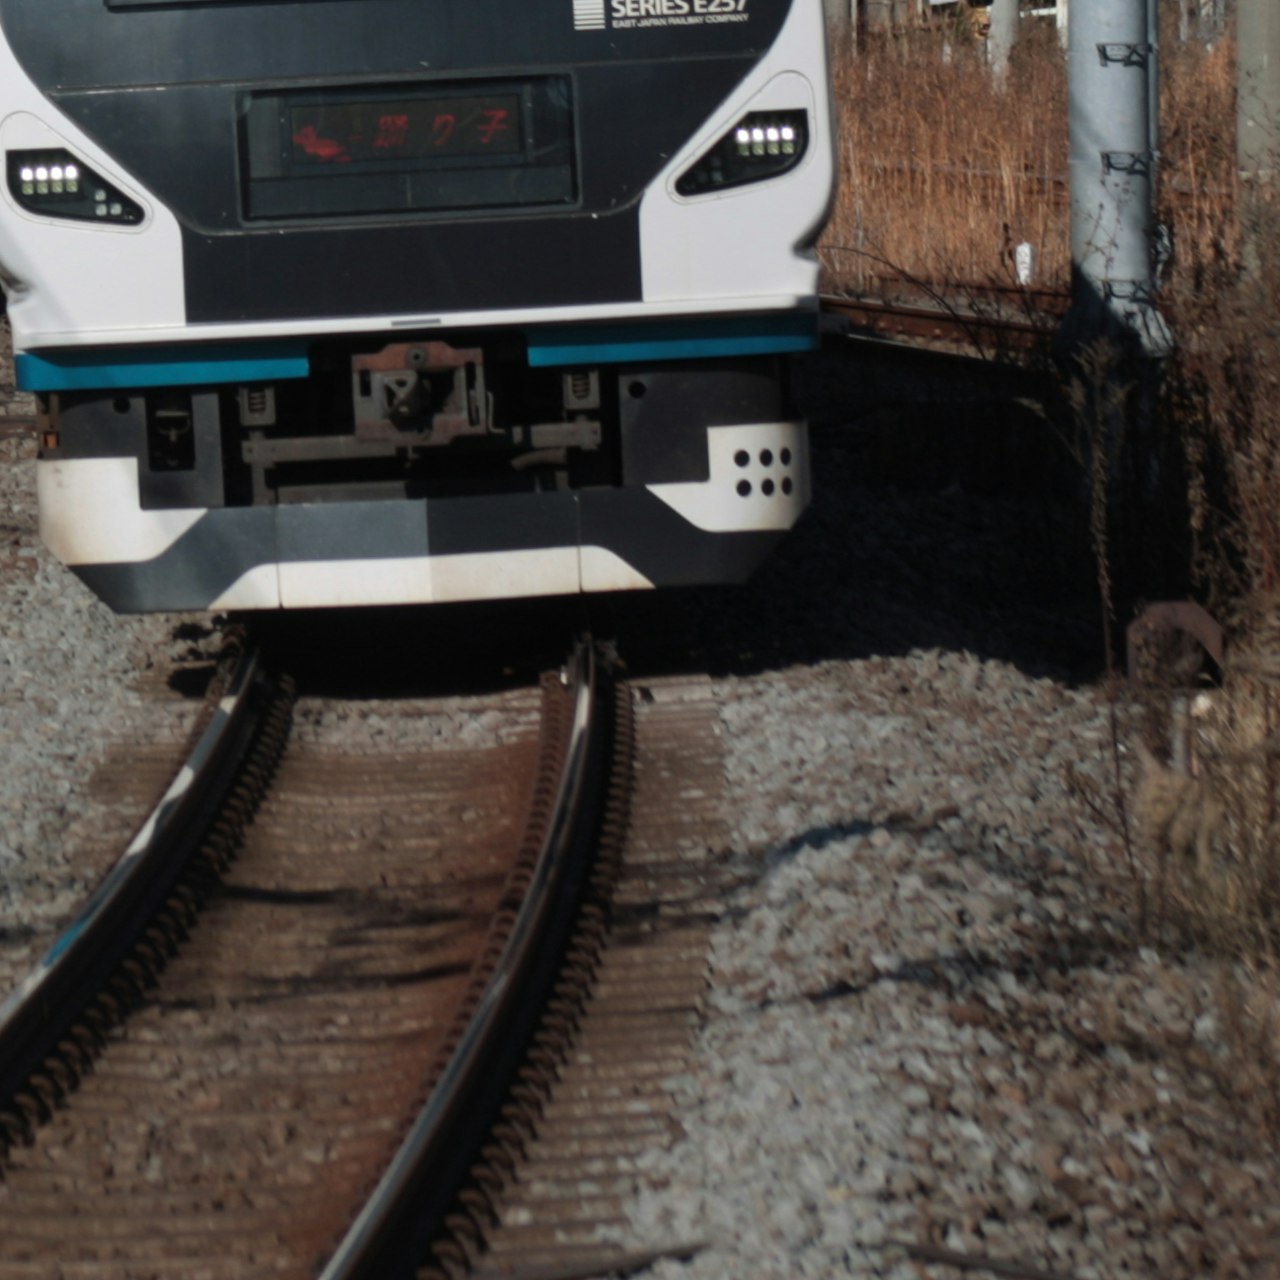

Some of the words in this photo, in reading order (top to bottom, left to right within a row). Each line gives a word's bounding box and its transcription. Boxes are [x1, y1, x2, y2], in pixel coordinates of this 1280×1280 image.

[612, 19, 637, 29] EAST
[637, 17, 668, 28] JAPAN
[668, 15, 705, 27] RAILWAY
[705, 12, 749, 25] COMPANY
